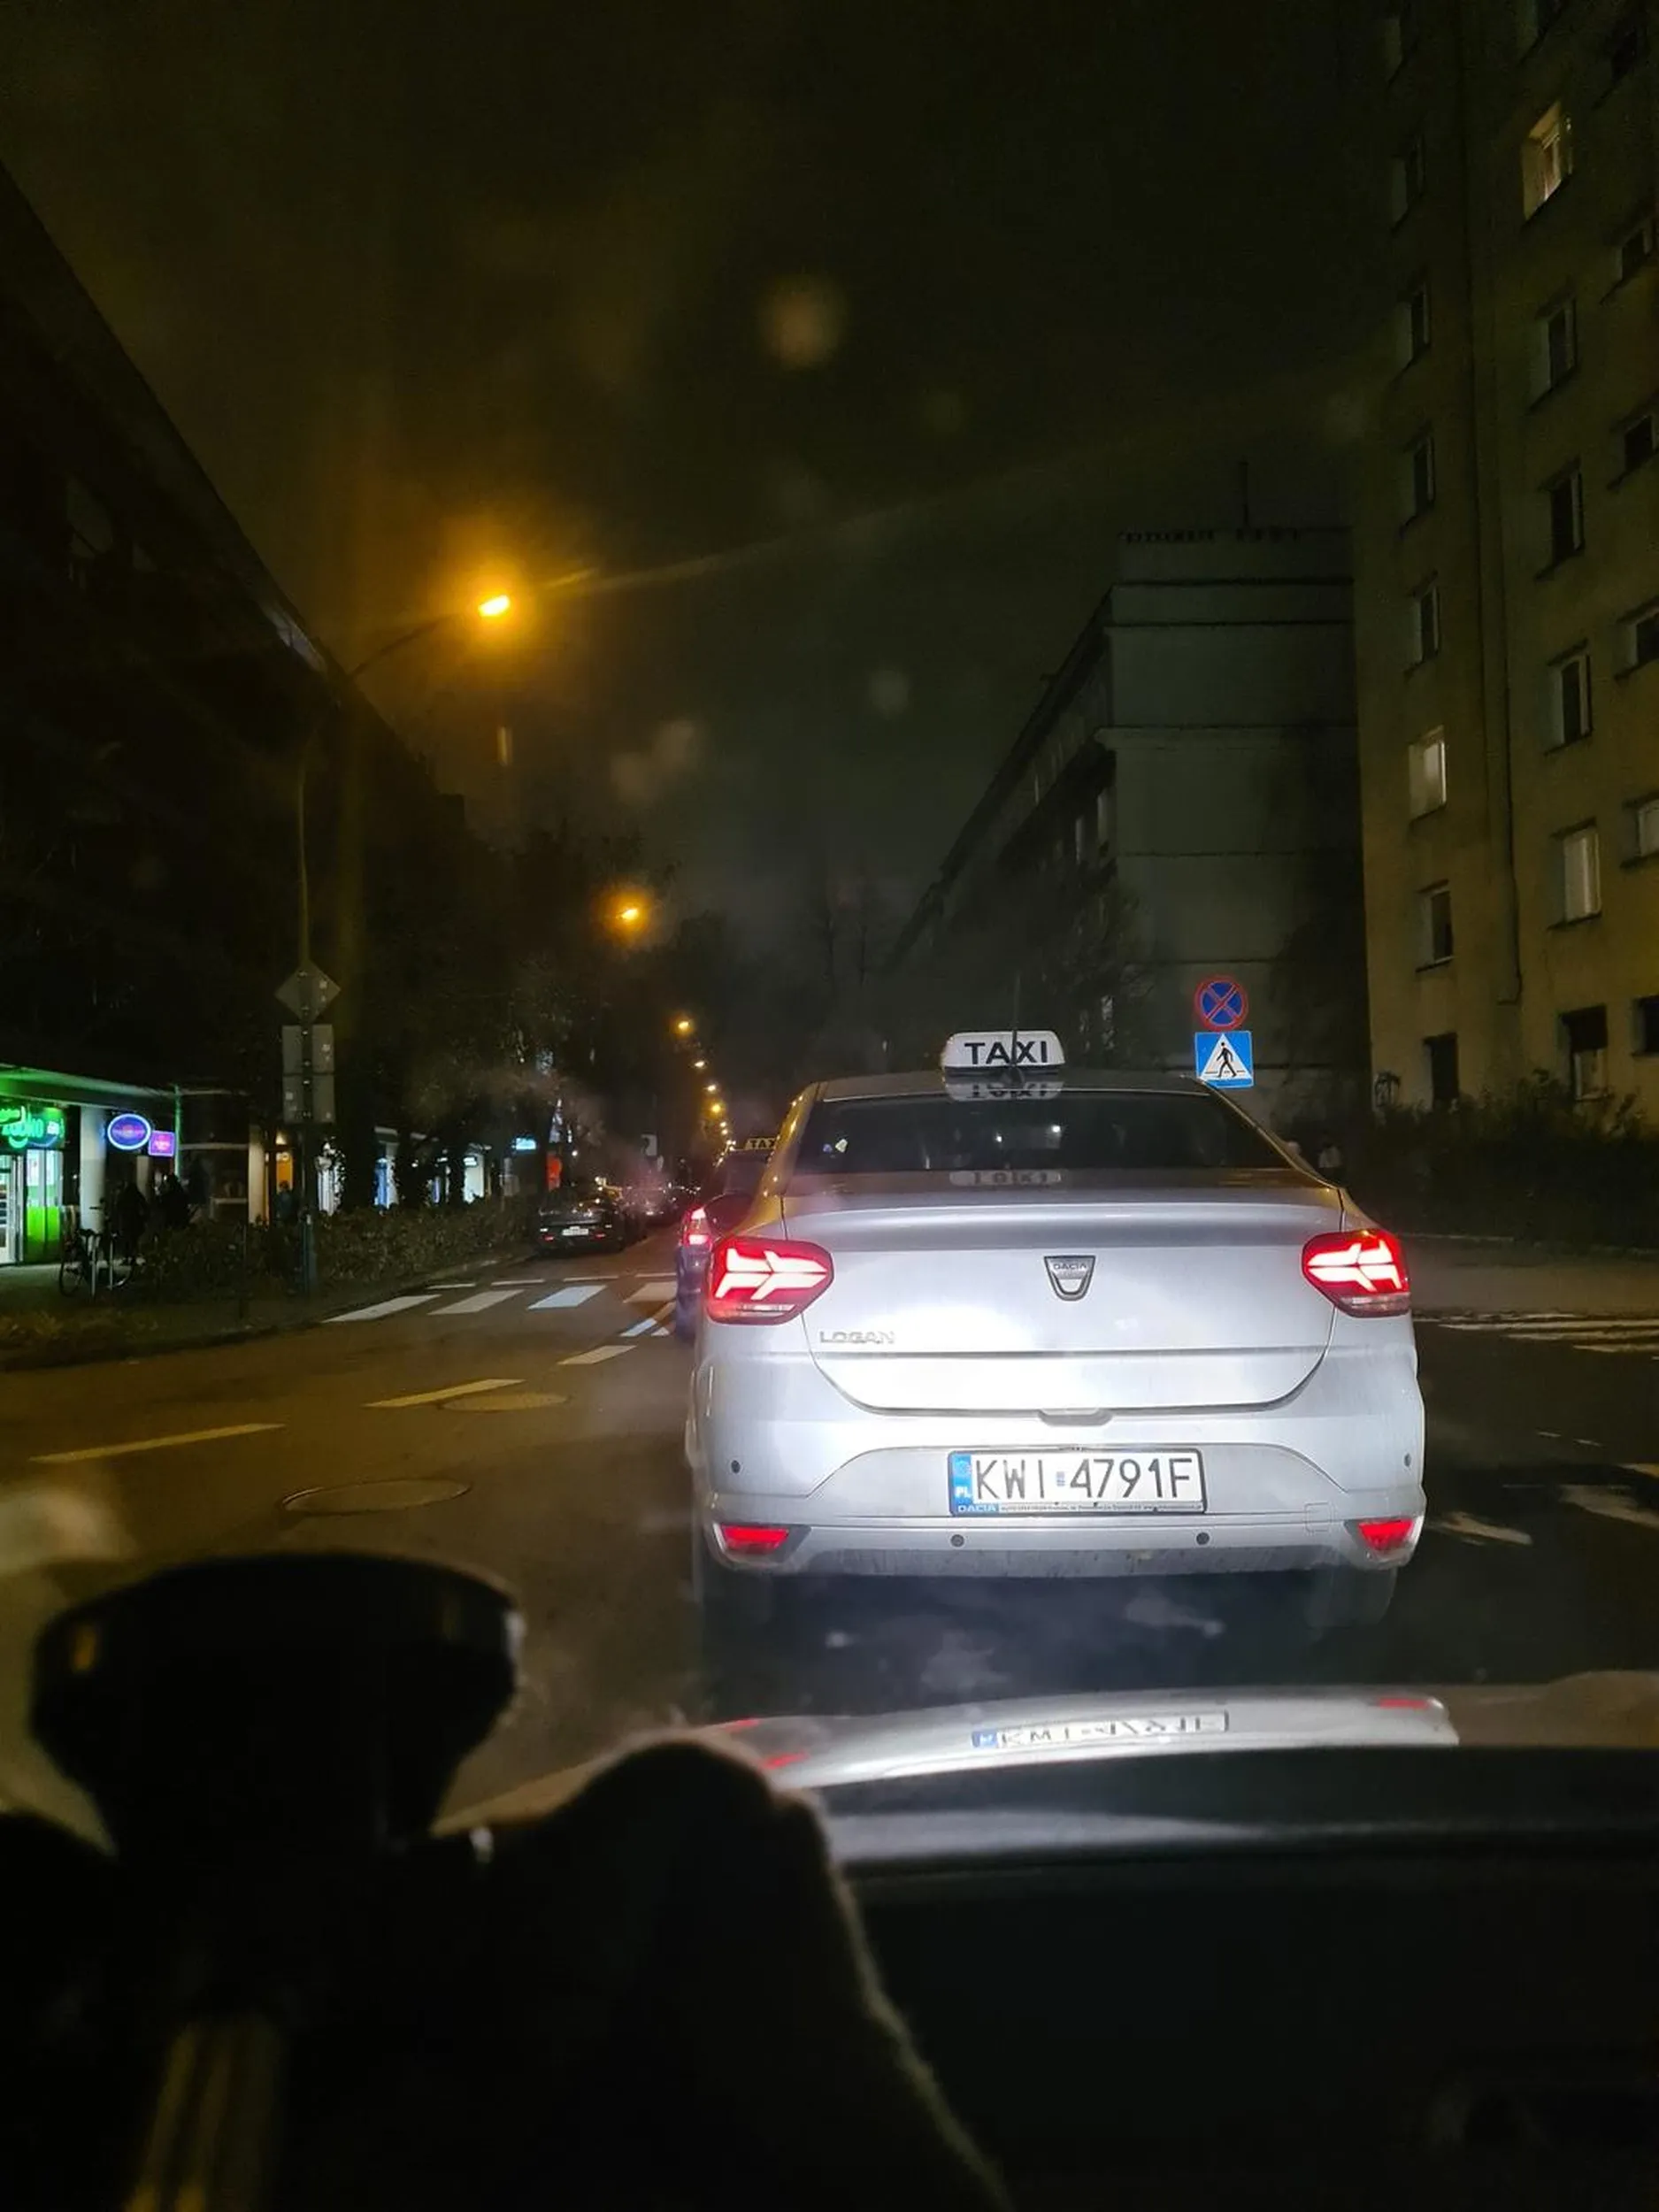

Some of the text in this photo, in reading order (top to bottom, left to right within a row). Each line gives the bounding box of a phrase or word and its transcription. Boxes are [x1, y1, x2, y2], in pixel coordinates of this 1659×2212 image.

[964, 1041, 1048, 1065] TAXI
[749, 1140, 776, 1149] TAX
[819, 1331, 895, 1345] LOGAN
[975, 1458, 1193, 1500] KWI 4791F
[955, 1486, 972, 1498] PL
[957, 1504, 997, 1513] DACIA
